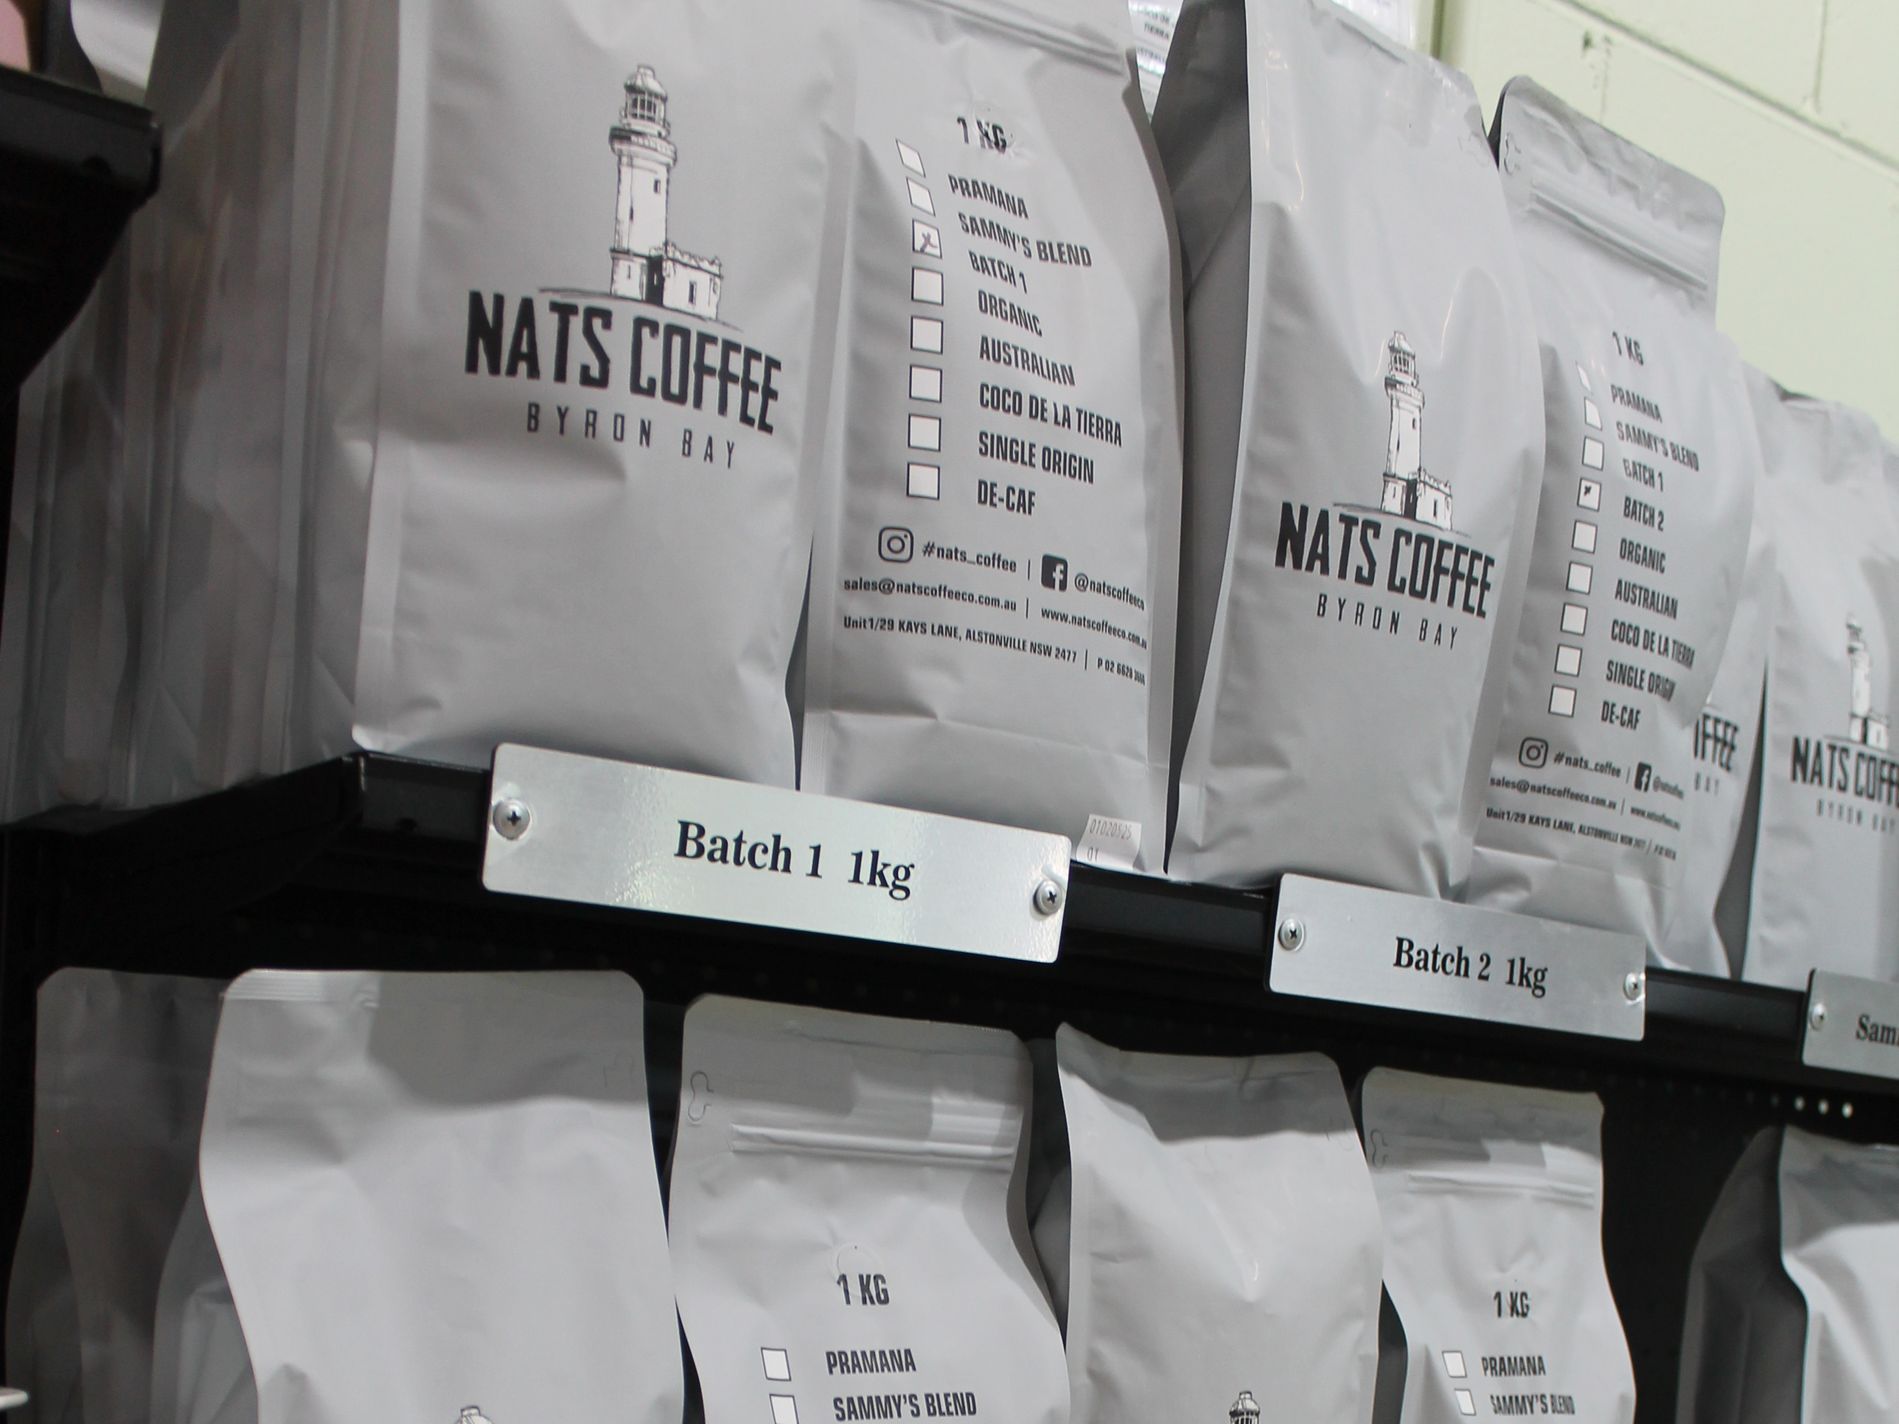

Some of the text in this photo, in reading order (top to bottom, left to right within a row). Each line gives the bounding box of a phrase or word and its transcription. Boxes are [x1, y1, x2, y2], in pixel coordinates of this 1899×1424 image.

[957, 117, 1007, 154] 1 KG
[948, 174, 1029, 220] PRAMANA
[958, 212, 1092, 267] SAMMY'S BLEND
[968, 250, 1028, 294] BATCH 1
[978, 289, 1042, 337] ORGANIC
[465, 290, 782, 434] NATS COFFEE
[979, 335, 1076, 386] AUSTRALIAN
[1612, 331, 1644, 366] 1 KG
[979, 382, 1122, 447] COCO DE LA TIERRA
[1610, 384, 1663, 424] PRAMANA
[526, 402, 735, 469] BYRON BAY
[978, 431, 1094, 484] SINGLE ORIGIN
[1623, 458, 1664, 492] BATCH 1
[1669, 441, 1700, 473] BLEND
[977, 478, 1036, 516] DE-CAF
[1623, 496, 1665, 532] BATCH 2
[922, 541, 1016, 573] #nats_coffee
[1274, 501, 1496, 620] NATS COFFEE
[1619, 537, 1666, 574] ORGANIC
[844, 577, 1016, 613] sales@natscoffeeco.com.au
[1614, 579, 1679, 620] AUSTRALIAN
[898, 617, 1078, 664] KAYS LANE, ALSTONVILLE NSW 2477
[1316, 593, 1458, 650] BYRON BAY
[1610, 618, 1639, 647] COCO
[1642, 631, 1656, 652] DE
[1657, 635, 1671, 658] LA
[1606, 659, 1645, 692] SINGLE
[1600, 700, 1641, 731] DE-CAF
[1790, 735, 1850, 793] NATS
[1528, 813, 1551, 830] KAYS
[674, 819, 915, 902] Batch 1 1kg
[1393, 936, 1548, 999] Batch 2 1kg
[837, 1273, 889, 1305] 1 KG
[1493, 1291, 1530, 1318] 1 KG
[826, 1348, 917, 1375] PRAMANA
[1481, 1355, 1546, 1377] PRAMANA
[833, 1392, 977, 1422] SAMMY'S BLEND
[1490, 1394, 1548, 1415] SAMMY'S
